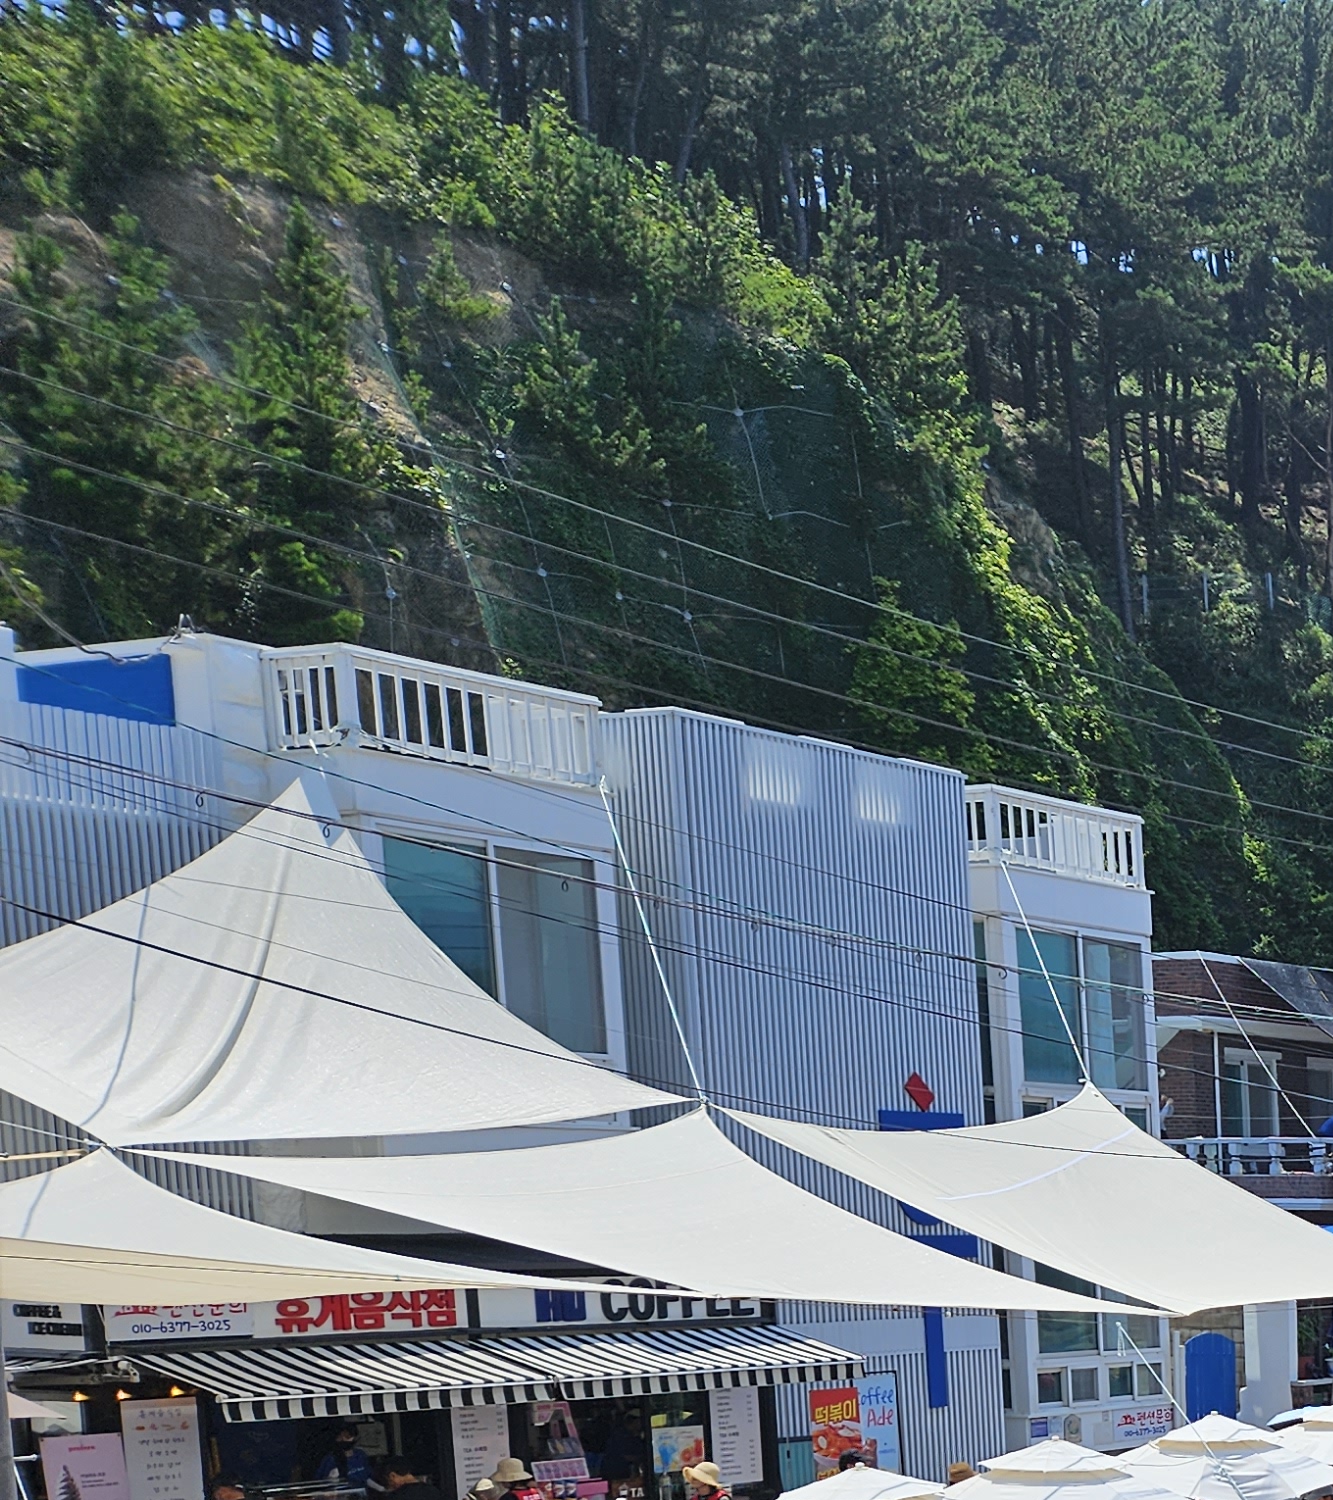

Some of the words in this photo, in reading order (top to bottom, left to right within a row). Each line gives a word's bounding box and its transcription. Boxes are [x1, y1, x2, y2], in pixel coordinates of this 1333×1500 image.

[132, 1319, 231, 1334] 010-6377-3025
[858, 1386, 893, 1406] offee
[815, 1398, 857, 1425] 떡볶이
[867, 1406, 893, 1427] Ade
